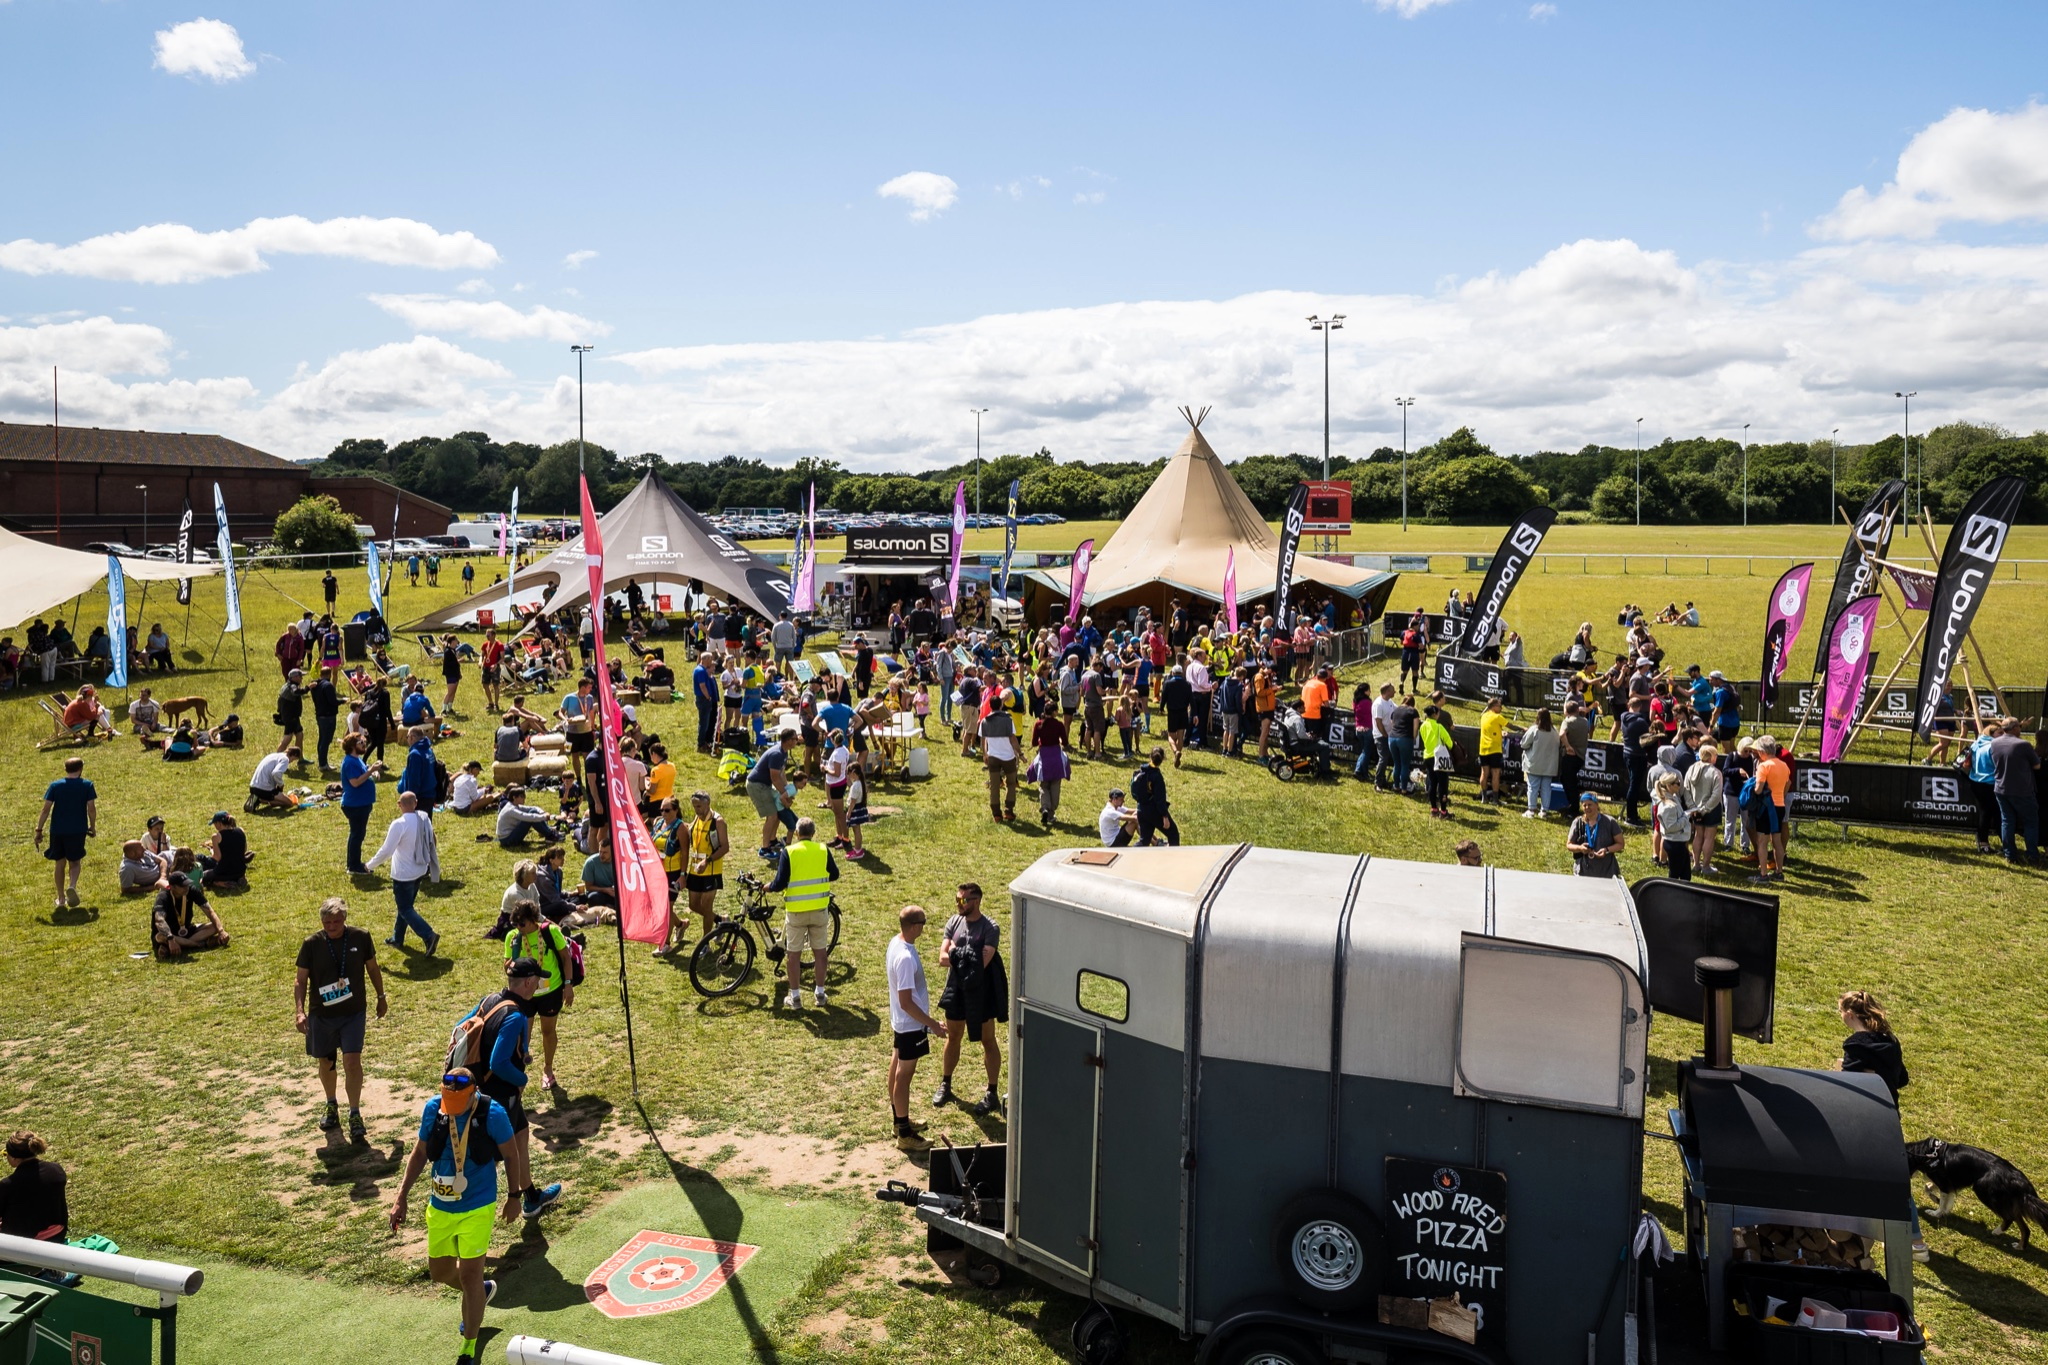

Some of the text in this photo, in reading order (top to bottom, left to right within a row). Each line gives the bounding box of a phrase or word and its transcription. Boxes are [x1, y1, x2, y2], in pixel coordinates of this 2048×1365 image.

[626, 552, 684, 560] salomon
[853, 538, 926, 551] salomon
[1278, 539, 1296, 631] salomon
[1472, 554, 1522, 649] salomon
[1919, 567, 1985, 728] salomon
[1792, 792, 1850, 804] salomon
[1917, 801, 1977, 813] salomon
[1392, 1190, 1506, 1234] WOOD FIRED
[658, 1235, 734, 1252] ESTD 1927
[1416, 1217, 1488, 1252] PIZZA
[1397, 1253, 1503, 1289] TONIGHT
[636, 1276, 720, 1313] COMMUNITY
